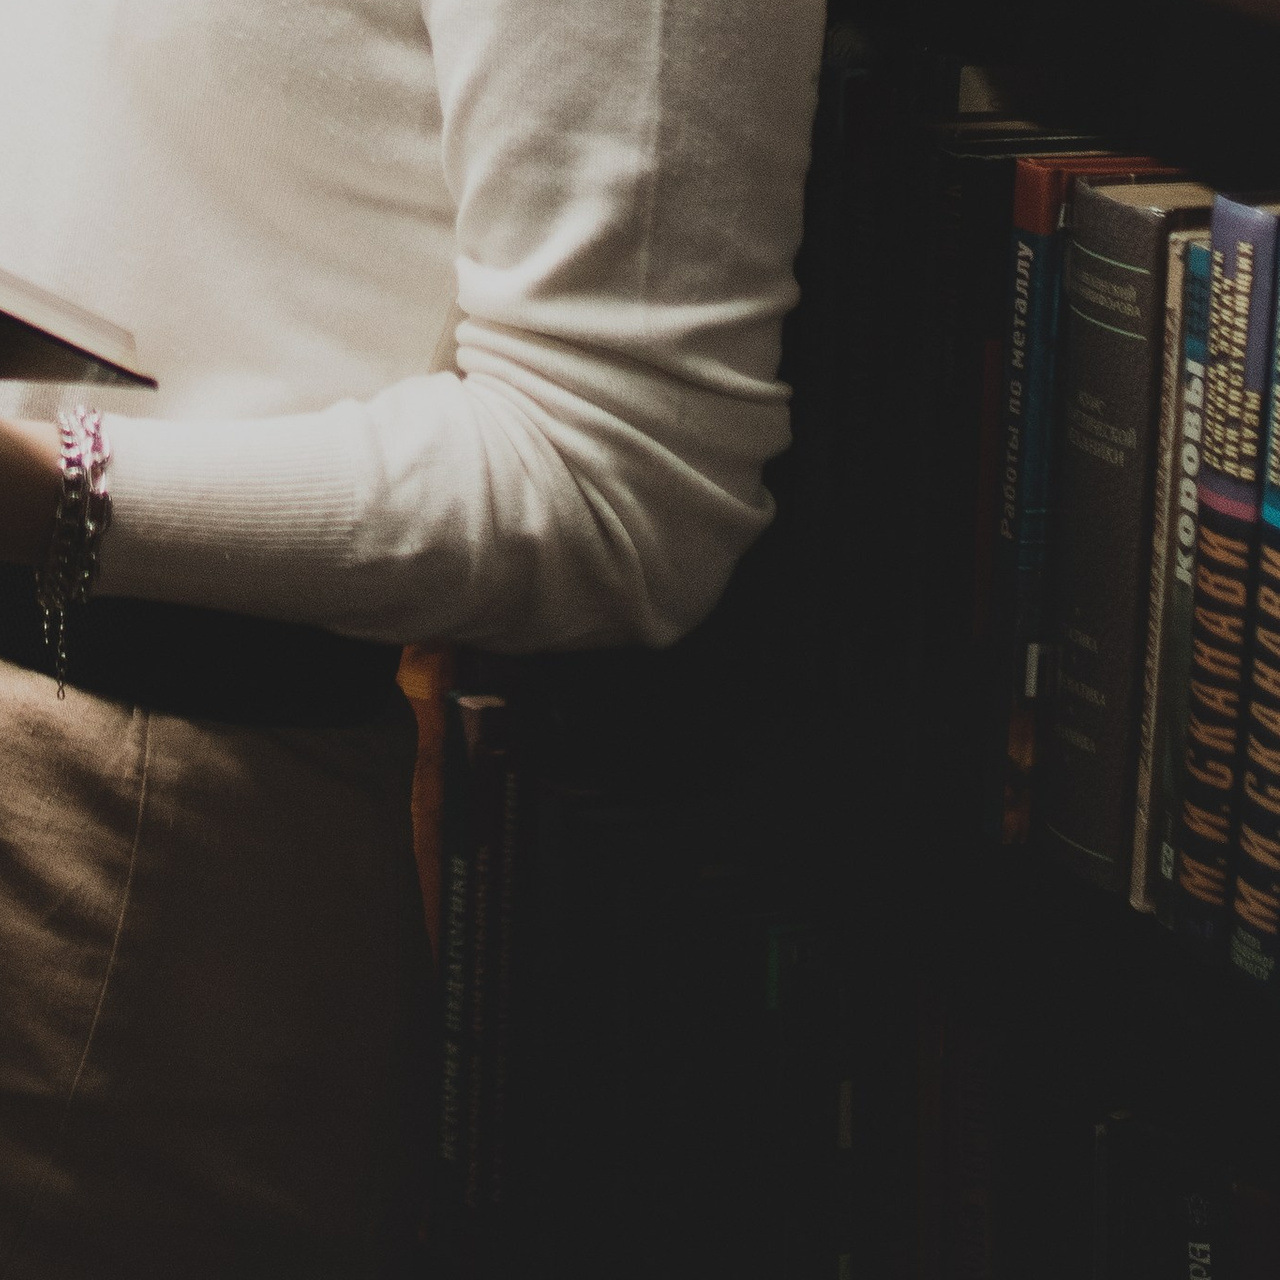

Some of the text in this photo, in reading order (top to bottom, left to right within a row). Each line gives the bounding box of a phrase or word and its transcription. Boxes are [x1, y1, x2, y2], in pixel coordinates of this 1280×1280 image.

[999, 241, 1035, 541] Работы по металлу
[1174, 358, 1205, 586] КОРОВЫ
